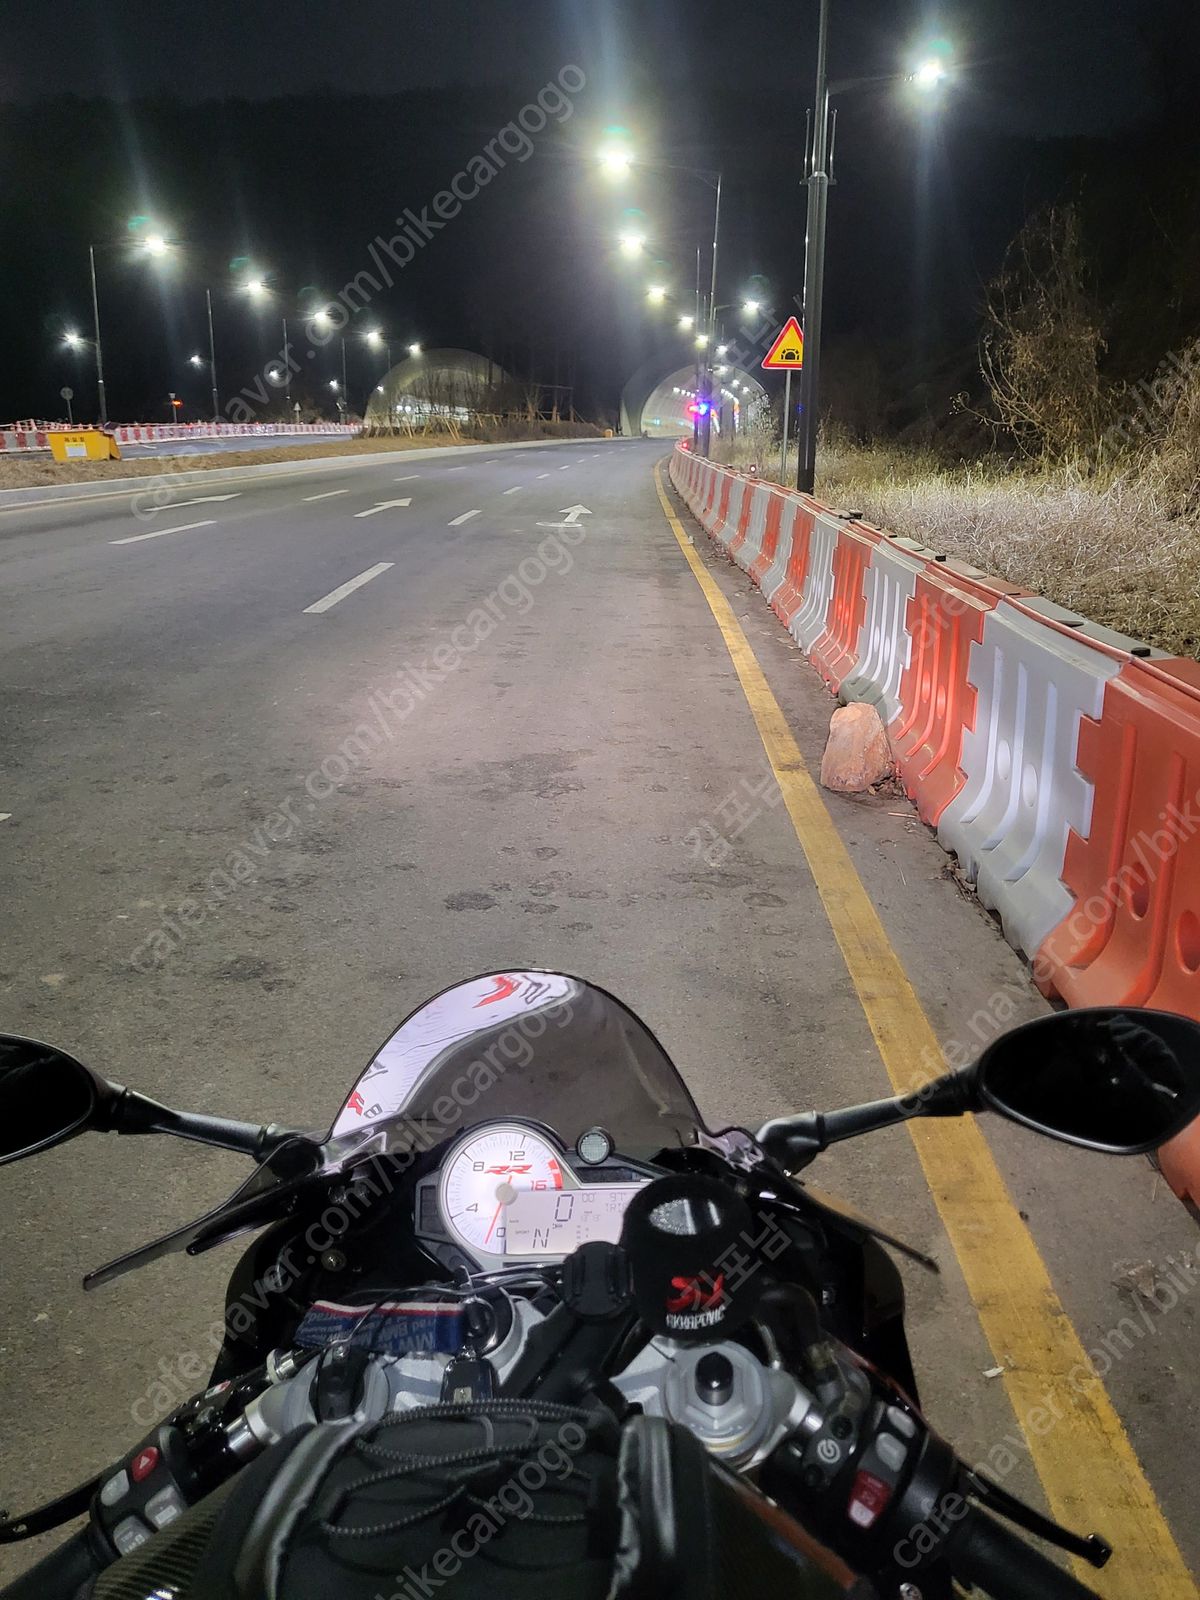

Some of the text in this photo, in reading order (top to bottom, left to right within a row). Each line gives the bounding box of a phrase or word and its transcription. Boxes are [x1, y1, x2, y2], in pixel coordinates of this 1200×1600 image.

[508, 1150, 525, 1161] 12
[473, 1161, 485, 1172] 8
[530, 1179, 547, 1191] 16
[466, 1202, 478, 1213] 4
[554, 1193, 574, 1222] 0
[532, 1227, 550, 1249] N
